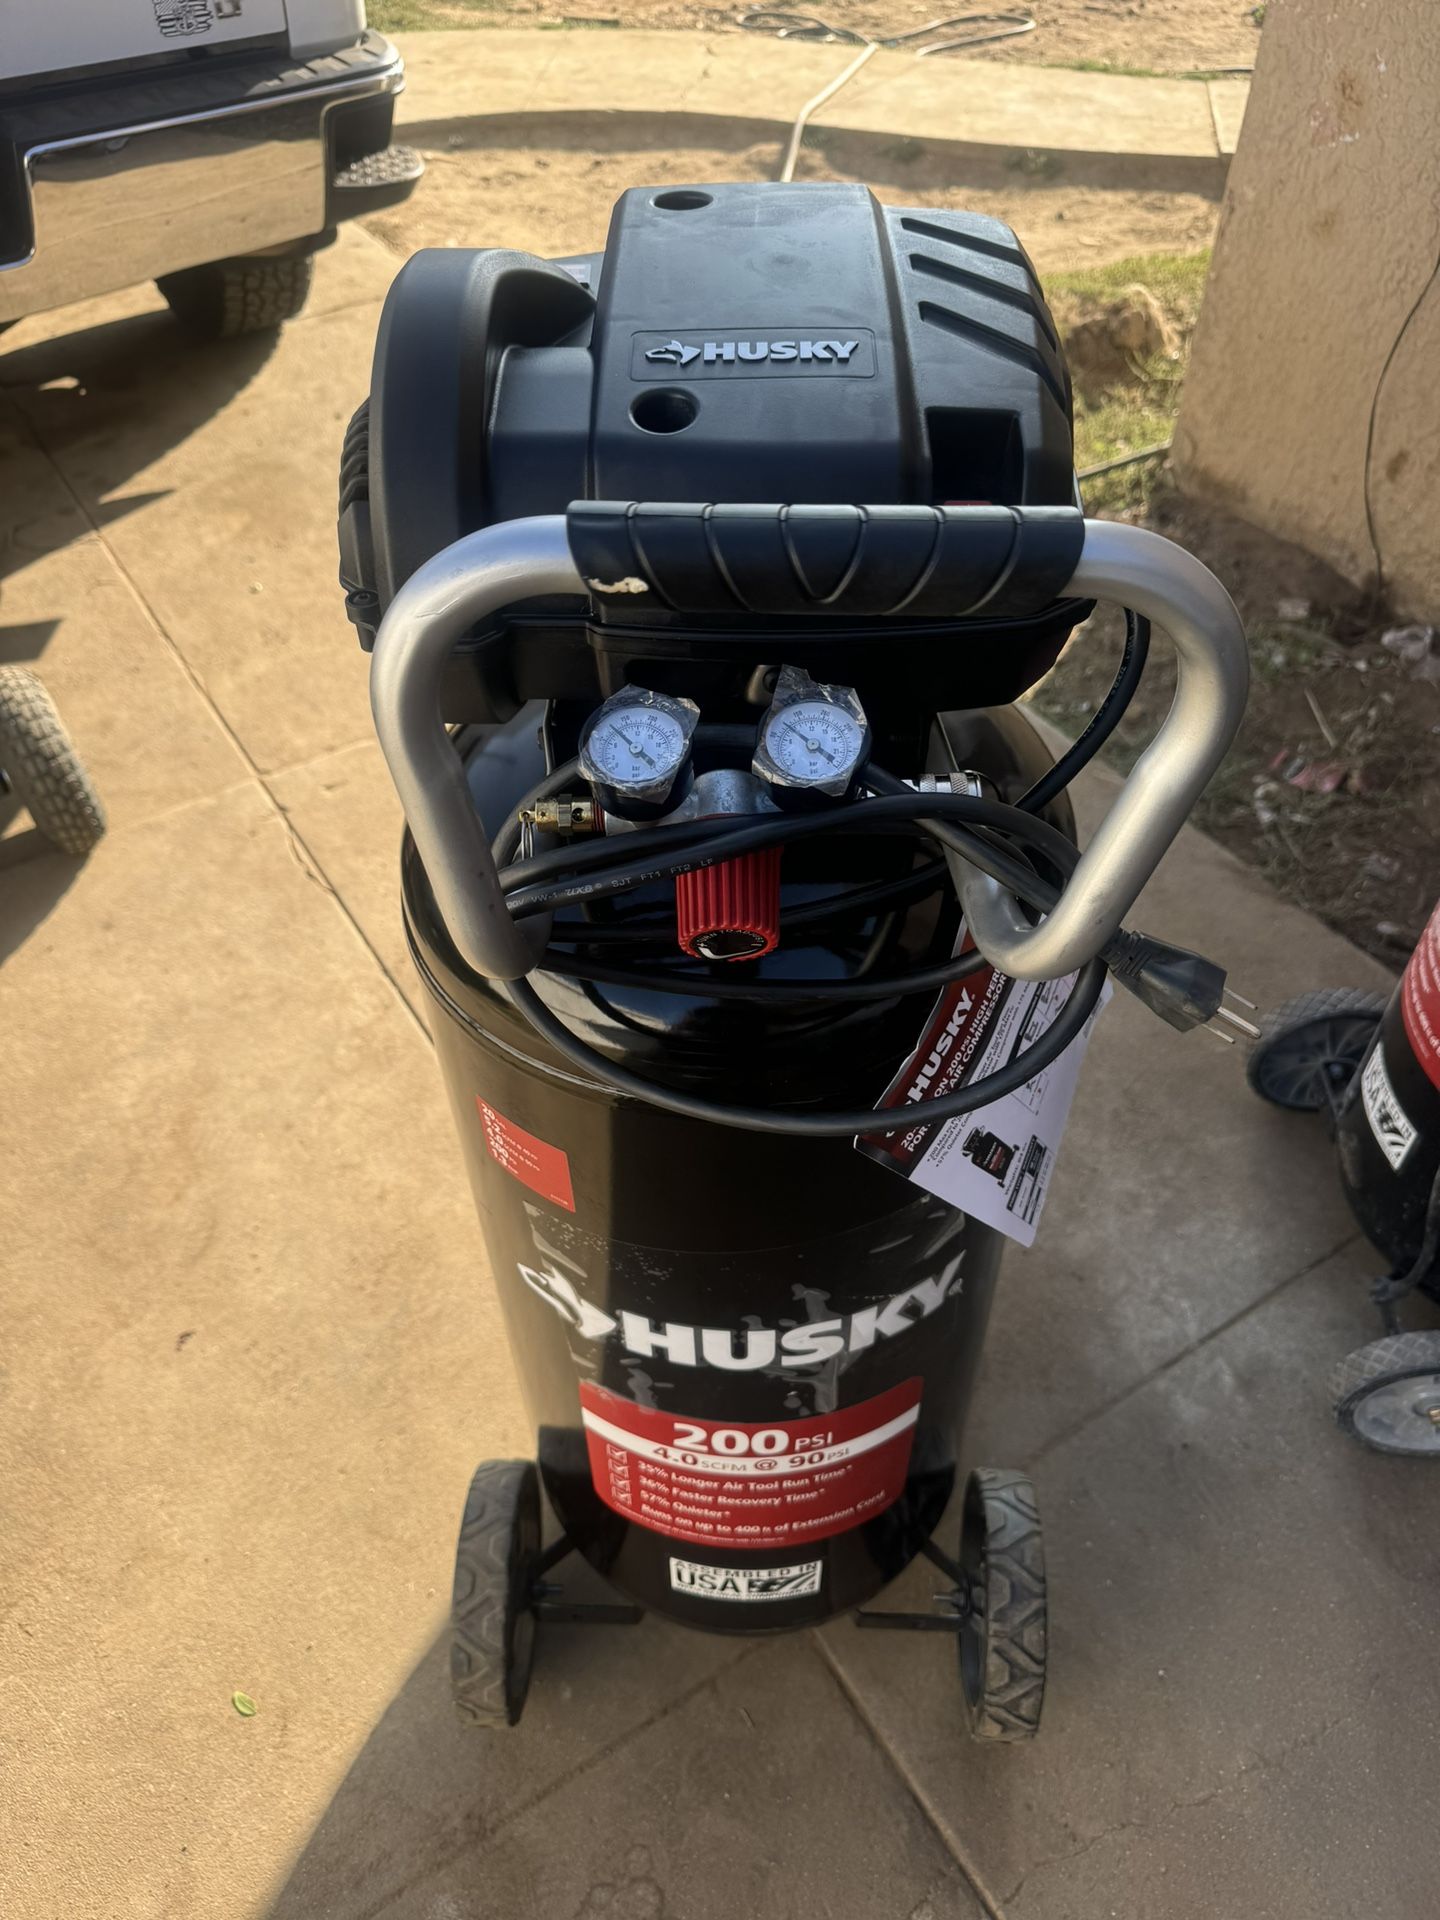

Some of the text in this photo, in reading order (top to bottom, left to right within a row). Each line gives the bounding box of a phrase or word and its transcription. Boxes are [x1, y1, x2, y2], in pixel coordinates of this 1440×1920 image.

[703, 341, 858, 362] HUSKY
[611, 877, 631, 888] SJT
[640, 870, 661, 881] FT1
[670, 863, 691, 874] FT2
[946, 1050, 962, 1076] 200
[960, 1035, 971, 1051] PSI
[969, 999, 989, 1033] HIGH
[949, 1065, 965, 1088] AIR
[962, 974, 1007, 1063] COMPRESSOR
[907, 987, 974, 1102] HUSKY
[620, 1249, 966, 1371] HUSKY
[672, 1422, 833, 1457] 200 PSI
[653, 1446, 850, 1472] 4.0 SCFM @ 90 PSI
[671, 1472, 720, 1489] Longer
[723, 1480, 744, 1491] Air
[749, 1481, 779, 1491] Tool
[782, 1477, 810, 1489] Run
[672, 1486, 715, 1503] Faster
[717, 1495, 781, 1506] Recovery
[641, 1503, 673, 1522] Runs
[674, 1516, 693, 1528] on
[694, 1521, 714, 1535] up
[716, 1522, 732, 1533] to
[733, 1525, 761, 1535] 400
[774, 1522, 789, 1534] of
[792, 1507, 855, 1530] Extension
[856, 1488, 886, 1509] Cord
[675, 1560, 818, 1578] ASSEMBLED IN
[676, 1568, 740, 1593] USA
